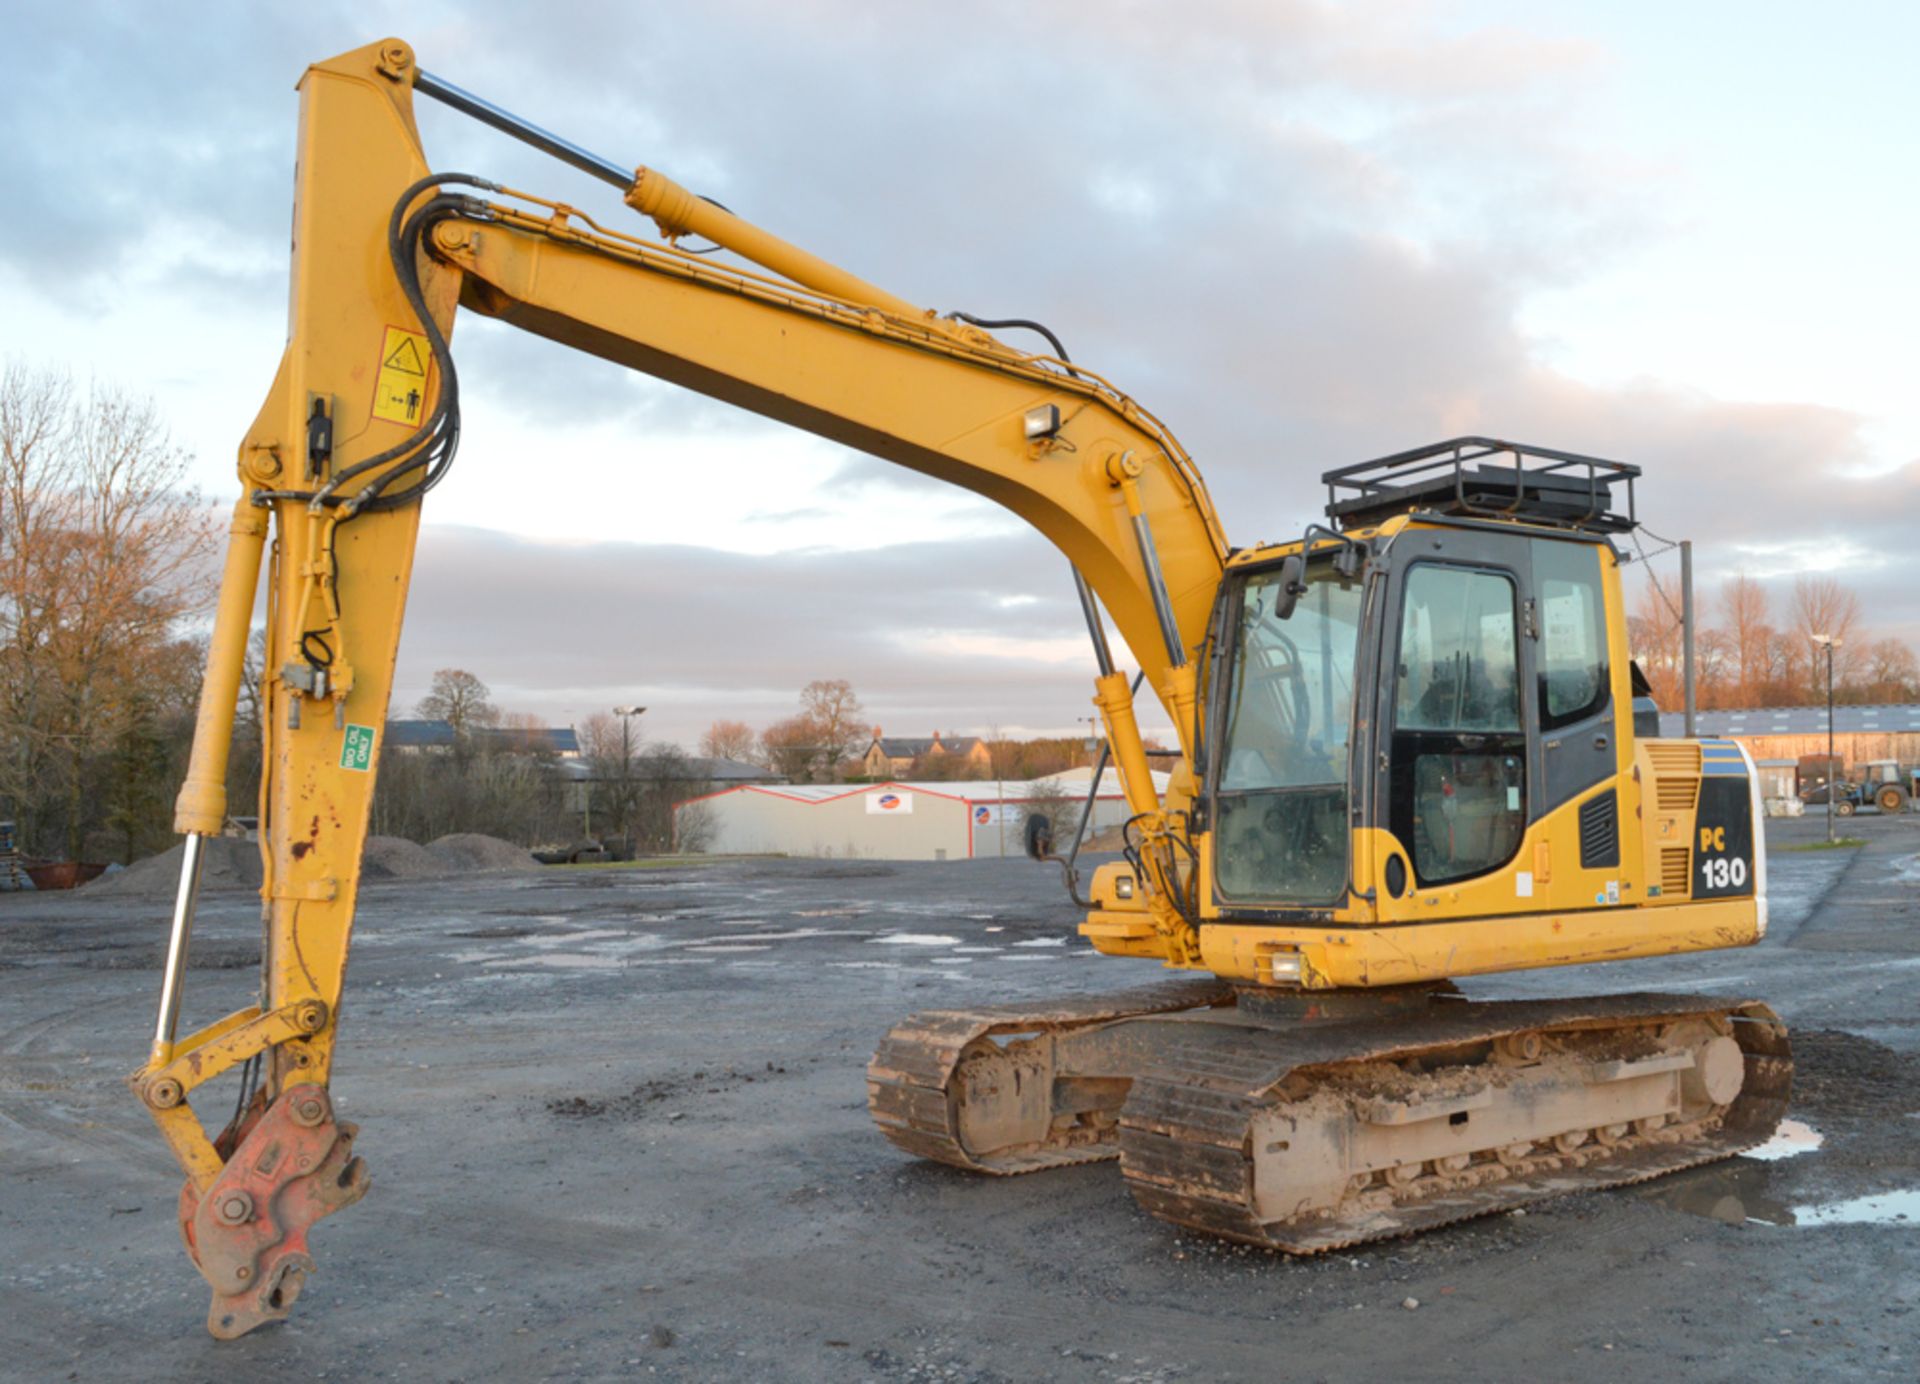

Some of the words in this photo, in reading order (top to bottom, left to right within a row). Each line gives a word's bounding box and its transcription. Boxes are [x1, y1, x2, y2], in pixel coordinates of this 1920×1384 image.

[349, 729, 360, 745] OIL
[357, 736, 369, 763] ONLY
[1701, 827, 1725, 853] PC
[1703, 858, 1746, 889] 130
